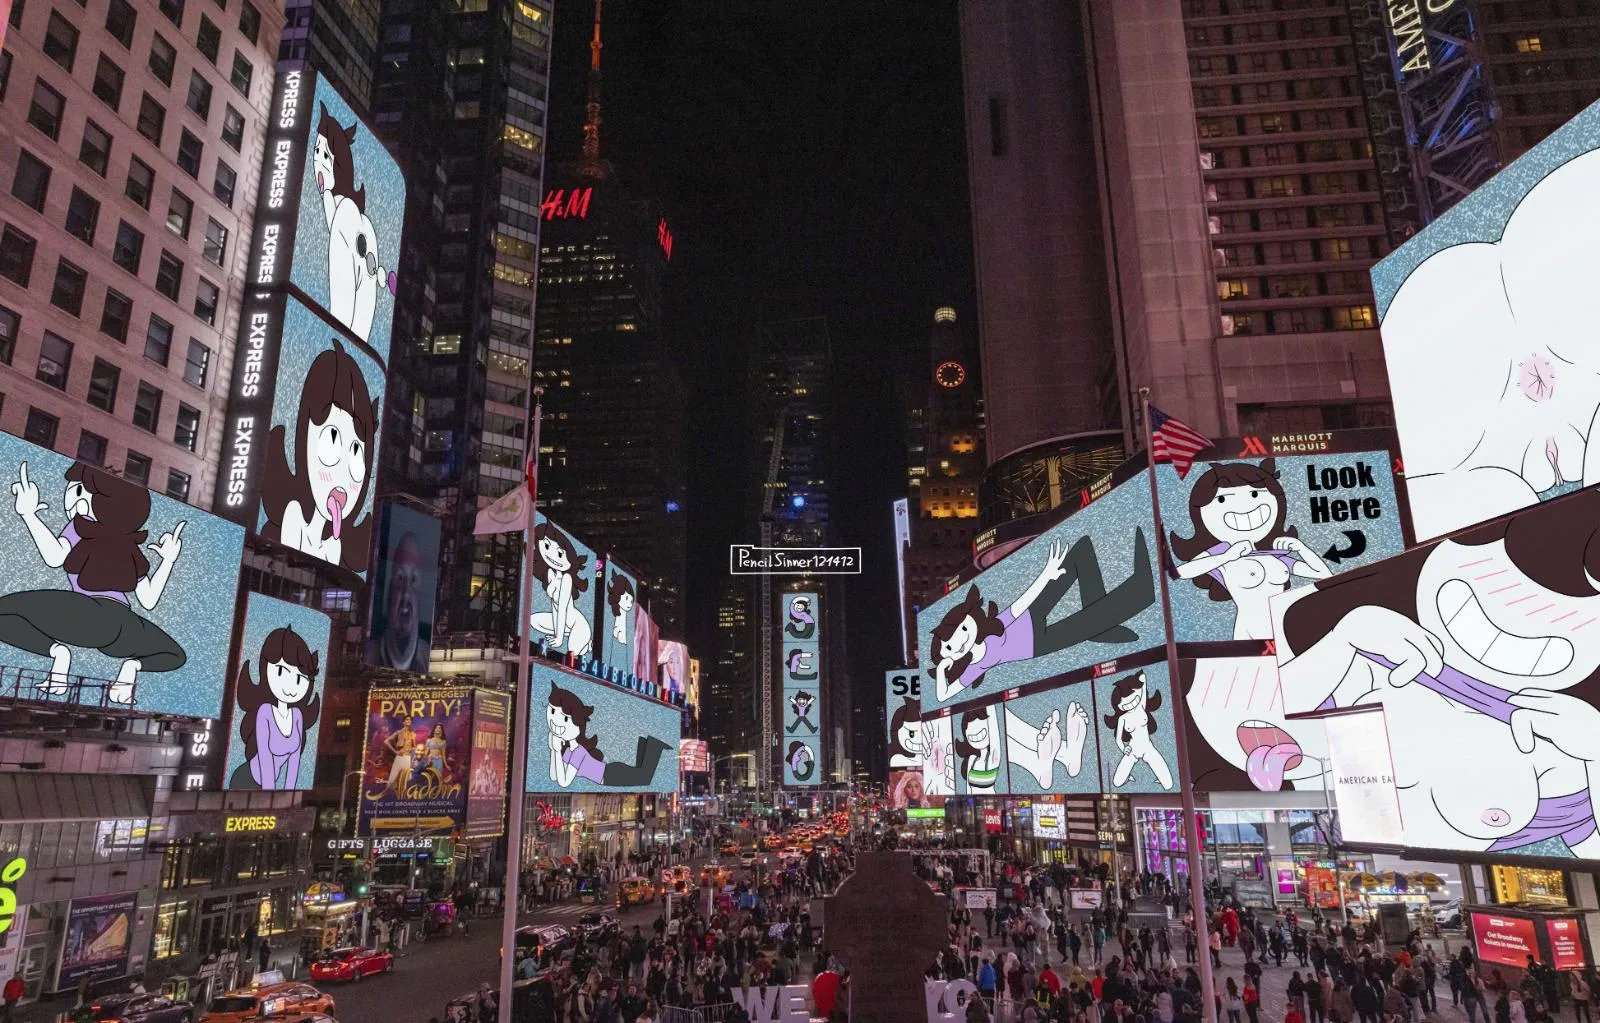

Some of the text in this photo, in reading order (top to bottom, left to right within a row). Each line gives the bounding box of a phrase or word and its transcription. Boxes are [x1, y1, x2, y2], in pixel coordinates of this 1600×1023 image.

[1387, 0, 1430, 72] AME
[269, 140, 291, 208] EXPRESS
[540, 187, 593, 220] H&M
[242, 313, 268, 397] EXPRESS
[1272, 432, 1333, 444] MARRIOTT
[1273, 442, 1328, 453] MARQUIS
[227, 416, 254, 506] EXPRESS
[1307, 462, 1376, 491] Look
[1310, 496, 1381, 524] Here
[372, 690, 470, 700] BROADWAY'S BIGGEST
[380, 699, 461, 718] PARTY!
[366, 768, 461, 801] Aladdin
[1338, 775, 1378, 785] AMERICAN
[226, 815, 277, 832] EXPRESS
[1098, 831, 1125, 842] SEPHRA
[327, 838, 432, 849] GIFTS LUGGAGE
[730, 984, 810, 1023] WE
